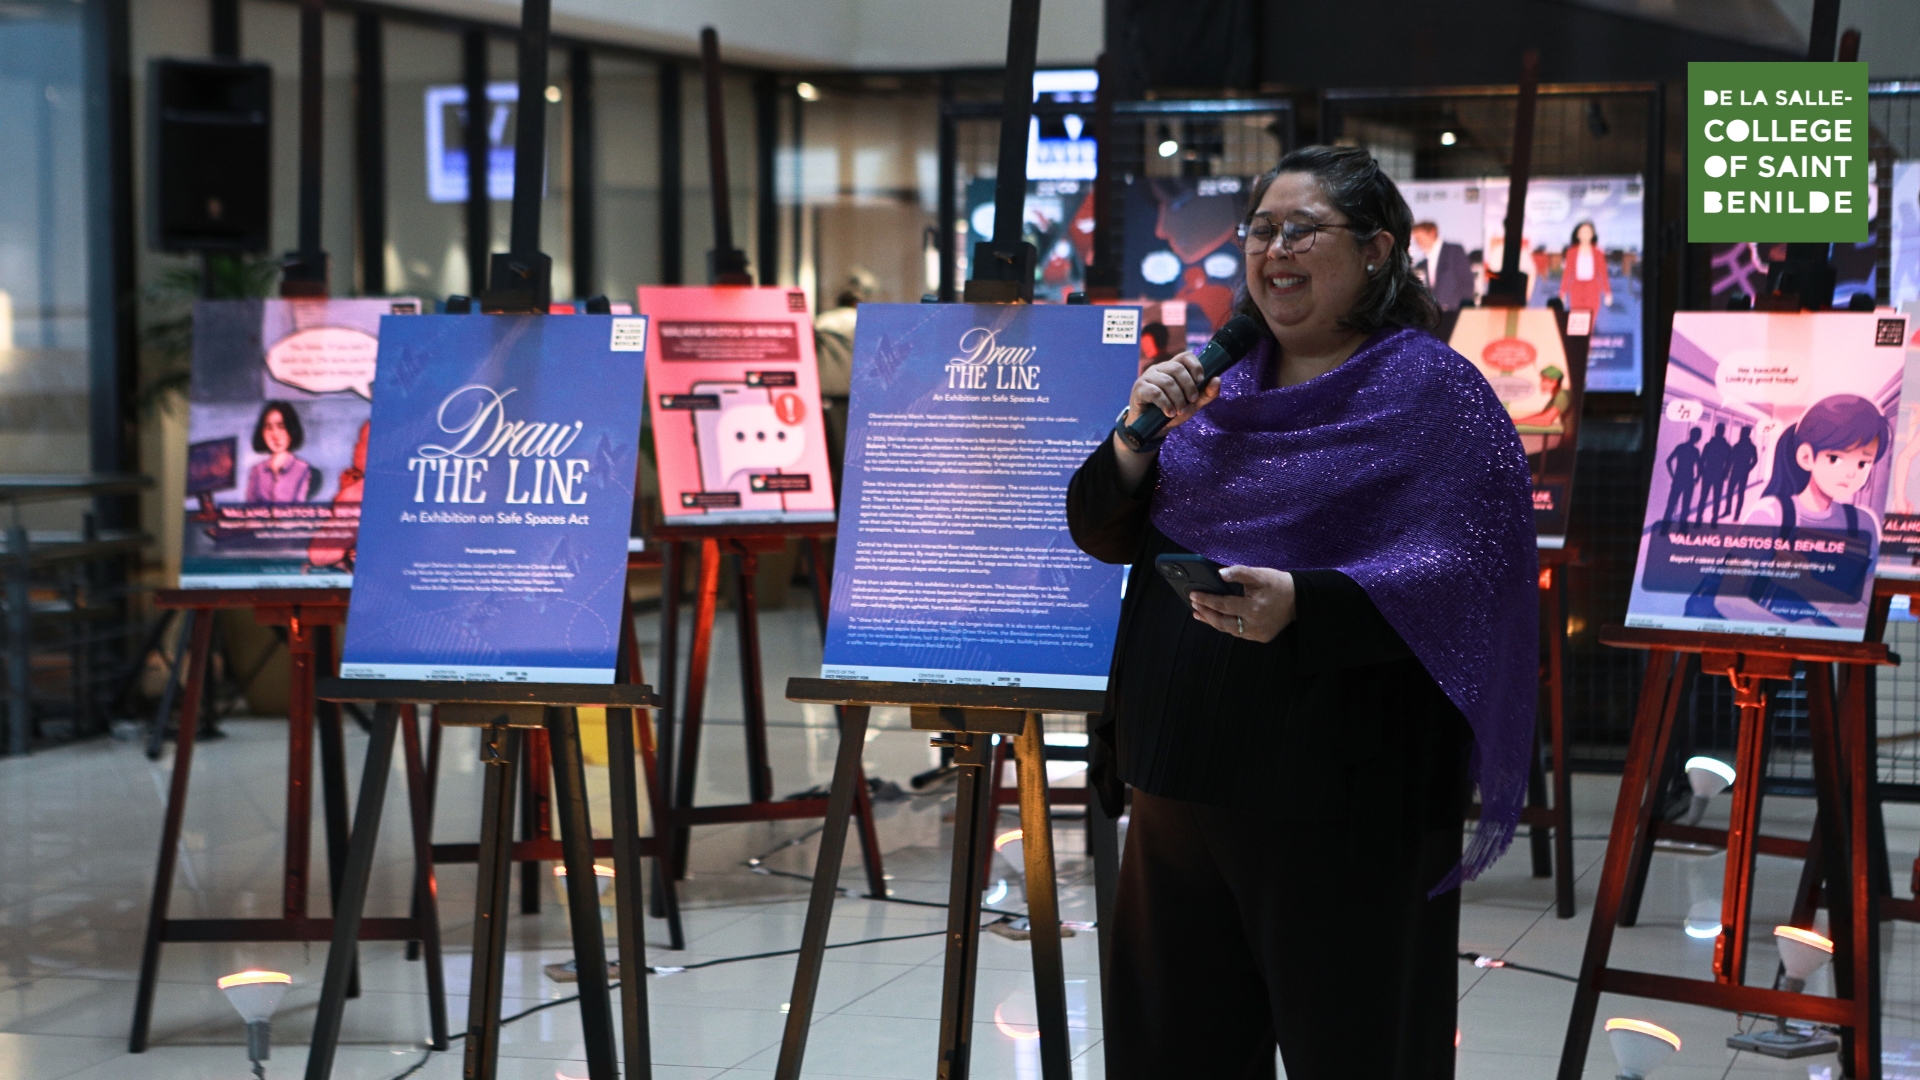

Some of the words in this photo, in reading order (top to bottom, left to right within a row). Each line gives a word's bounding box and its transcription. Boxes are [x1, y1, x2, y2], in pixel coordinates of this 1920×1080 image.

[950, 327, 1036, 365] Draw
[945, 365, 987, 389] THE
[996, 366, 1040, 390] LINE
[1010, 395, 1034, 404] Spaces
[417, 384, 583, 458] Draw
[408, 458, 488, 503] THE
[505, 459, 589, 504] LINE
[401, 512, 417, 523] An
[420, 512, 476, 523] Exhibition
[479, 515, 494, 524] on
[497, 512, 523, 524] Safe
[525, 513, 565, 526] Spaces
[568, 514, 589, 525] Act
[1668, 532, 1722, 547] WALANG
[1723, 536, 1772, 550] BASTOS
[1774, 538, 1790, 550] SA
[1794, 540, 1846, 554] BENILDE
[1716, 556, 1724, 564] of
[1760, 559, 1774, 568] and
[1827, 563, 1835, 571] to
